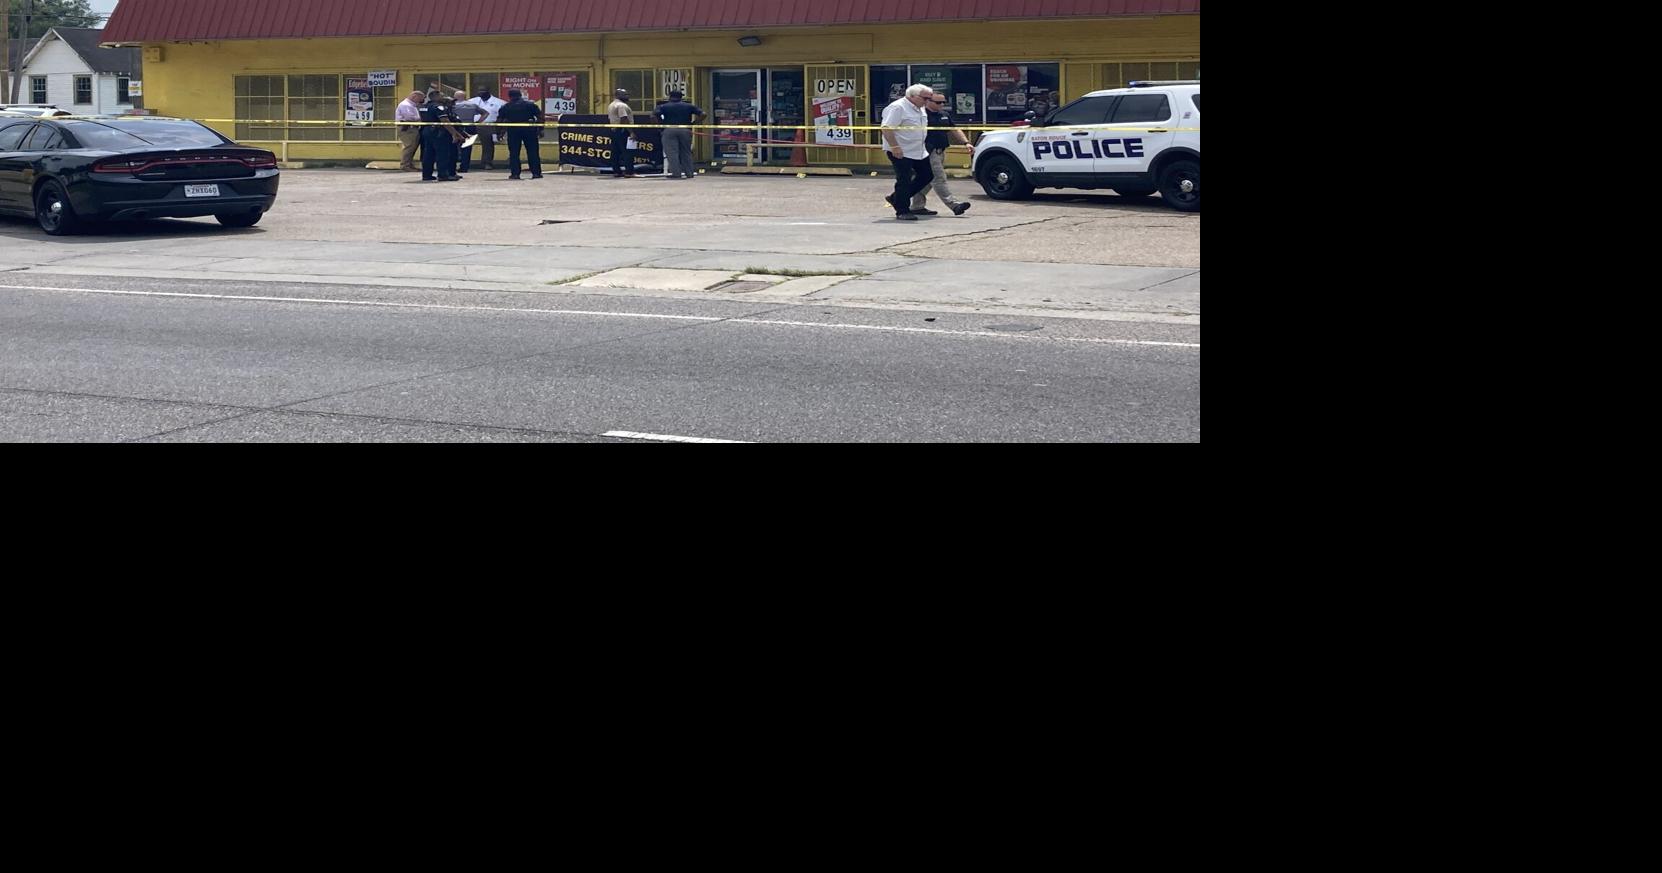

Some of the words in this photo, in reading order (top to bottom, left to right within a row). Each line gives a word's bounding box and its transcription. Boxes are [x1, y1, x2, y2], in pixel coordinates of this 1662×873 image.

[817, 79, 855, 93] OPEN
[560, 131, 594, 143] CRIME
[560, 145, 612, 159] 344-STO
[1032, 138, 1145, 160] POLICE
